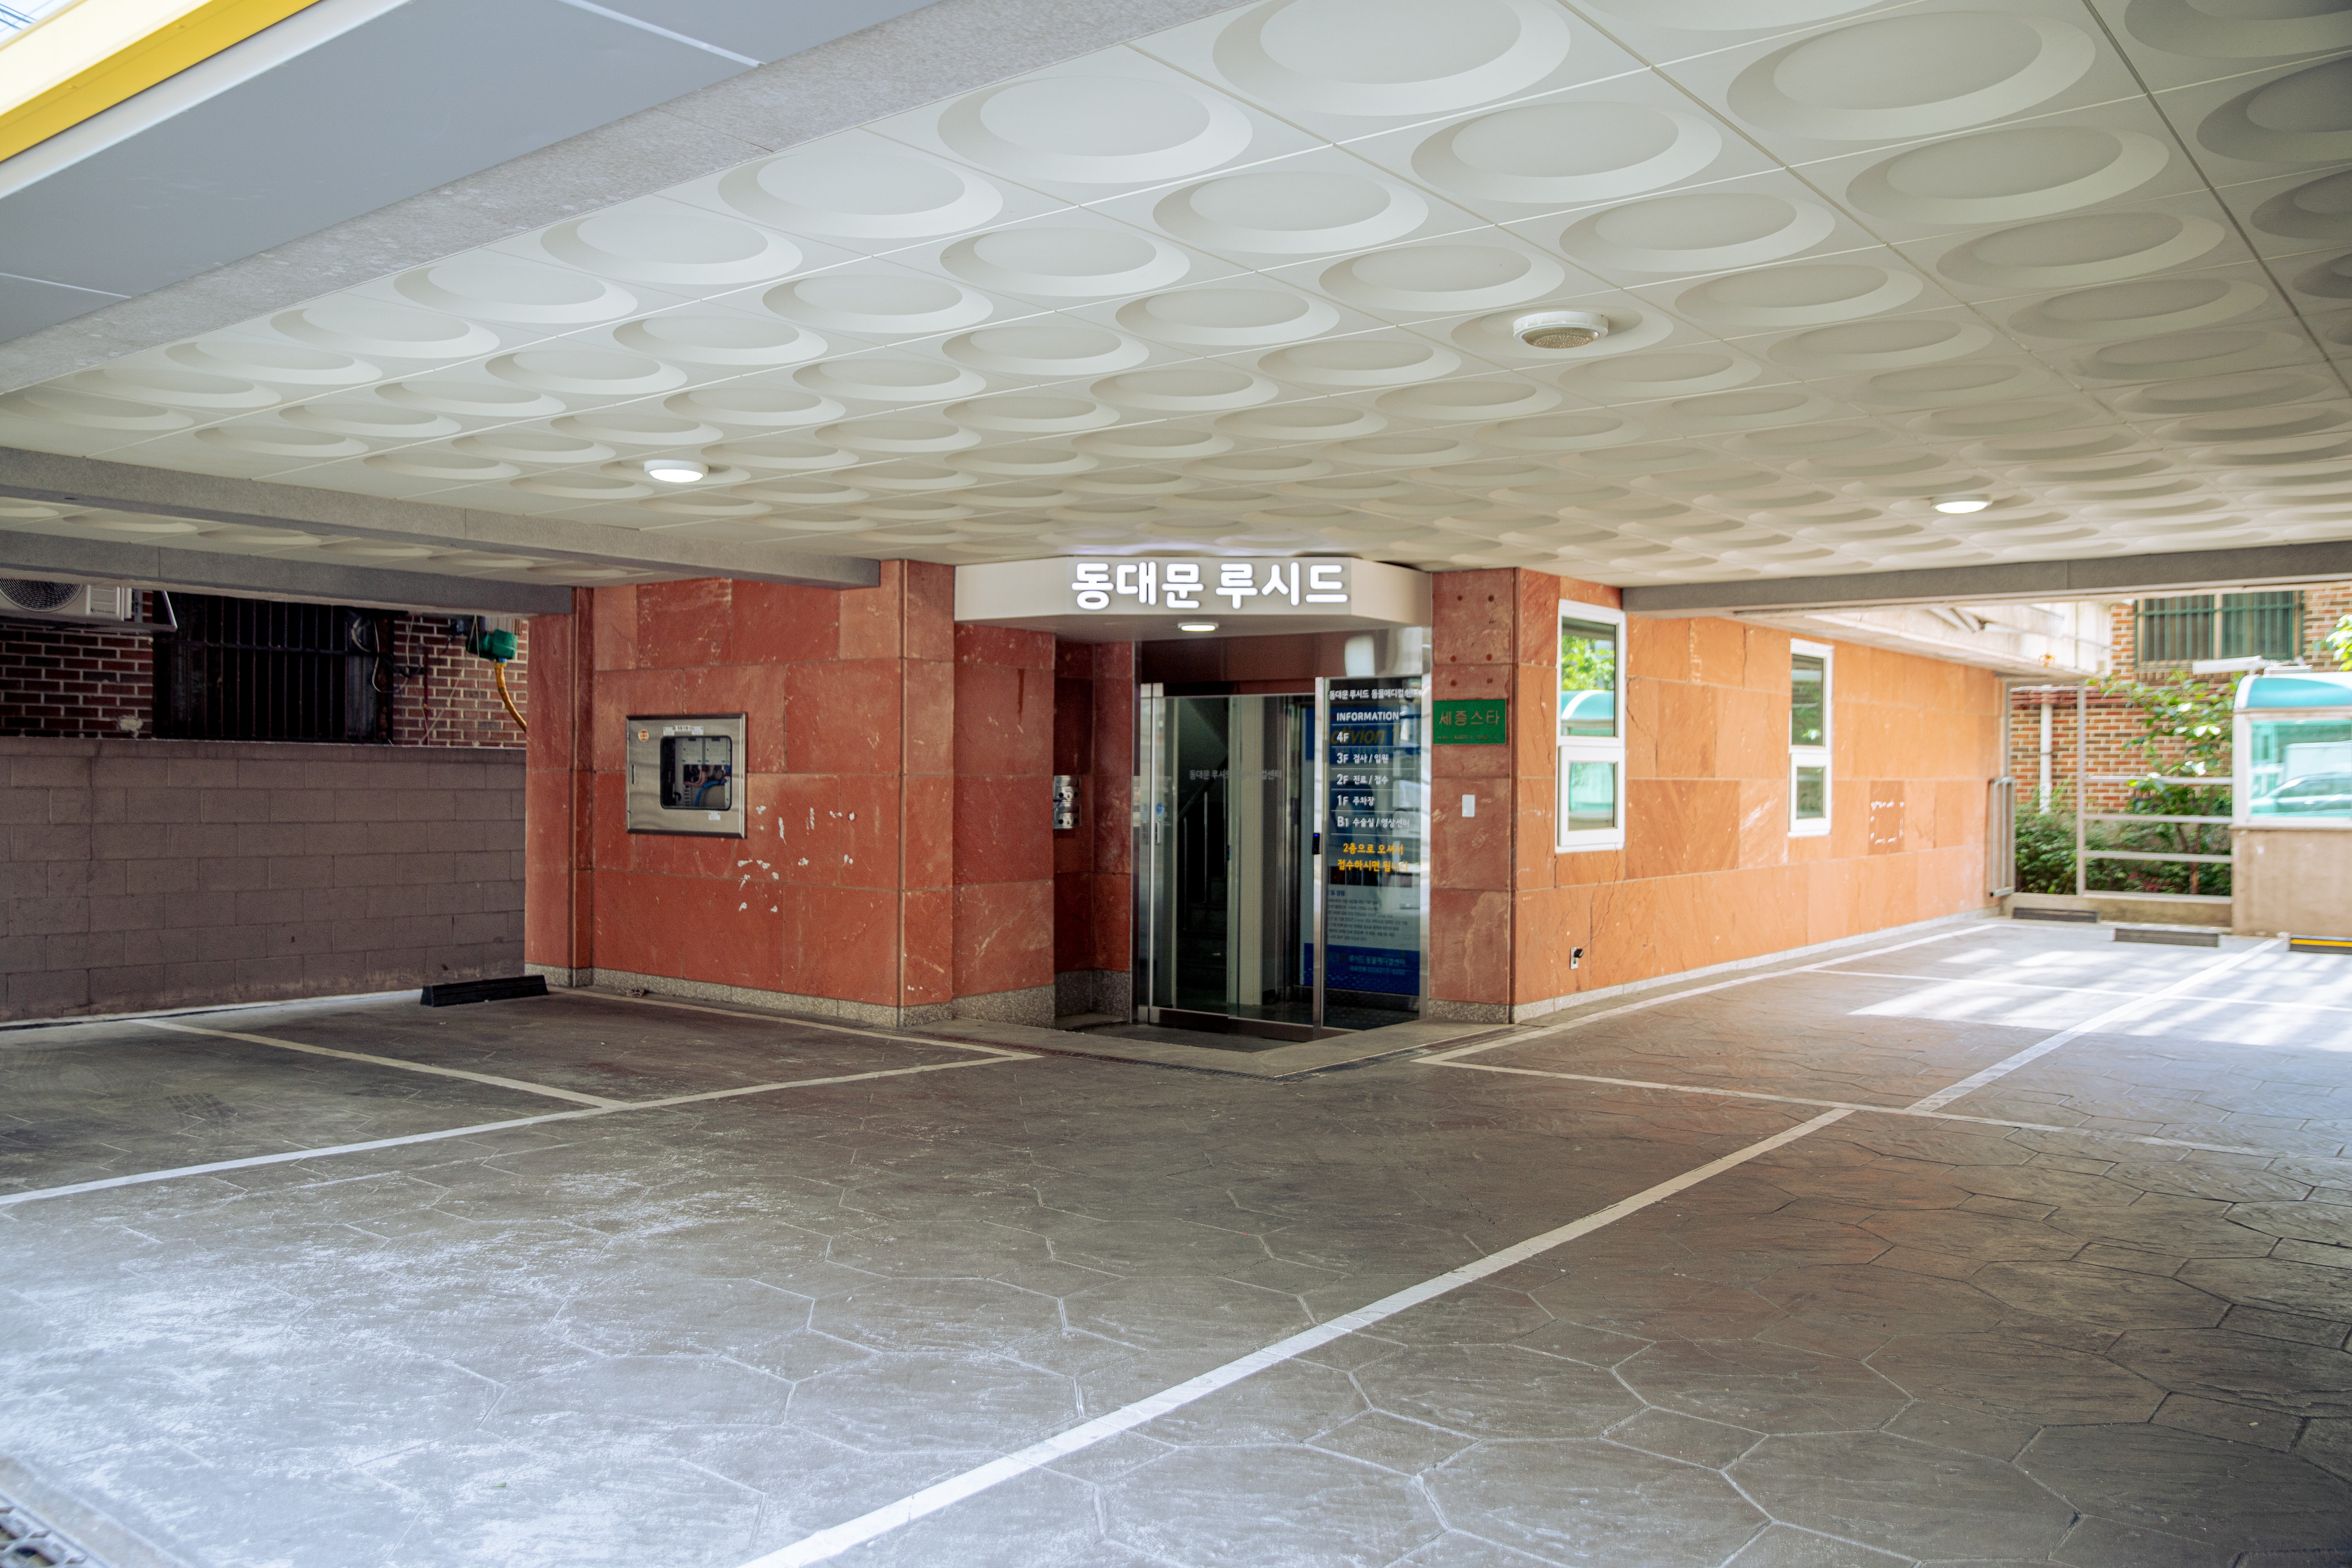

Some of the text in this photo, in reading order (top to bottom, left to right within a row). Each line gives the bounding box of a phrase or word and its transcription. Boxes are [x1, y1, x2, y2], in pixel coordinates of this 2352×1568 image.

[1071, 561, 1348, 610] 동대문 루시드
[1329, 690, 1349, 700] 동대문
[1350, 689, 1369, 700] 루시드
[1337, 711, 1400, 722] INFORMATION
[1337, 731, 1349, 743] 4F
[1337, 753, 1349, 764] 3F
[1337, 774, 1349, 786] 2F
[1353, 775, 1367, 786] 진료
[1374, 775, 1389, 785] 접수
[1337, 795, 1375, 806] 1F 주차장
[1337, 816, 1349, 827] B1
[1343, 842, 1404, 855] 2층으로 오셔서
[1338, 859, 1409, 873] 접수하시면 됩니다
